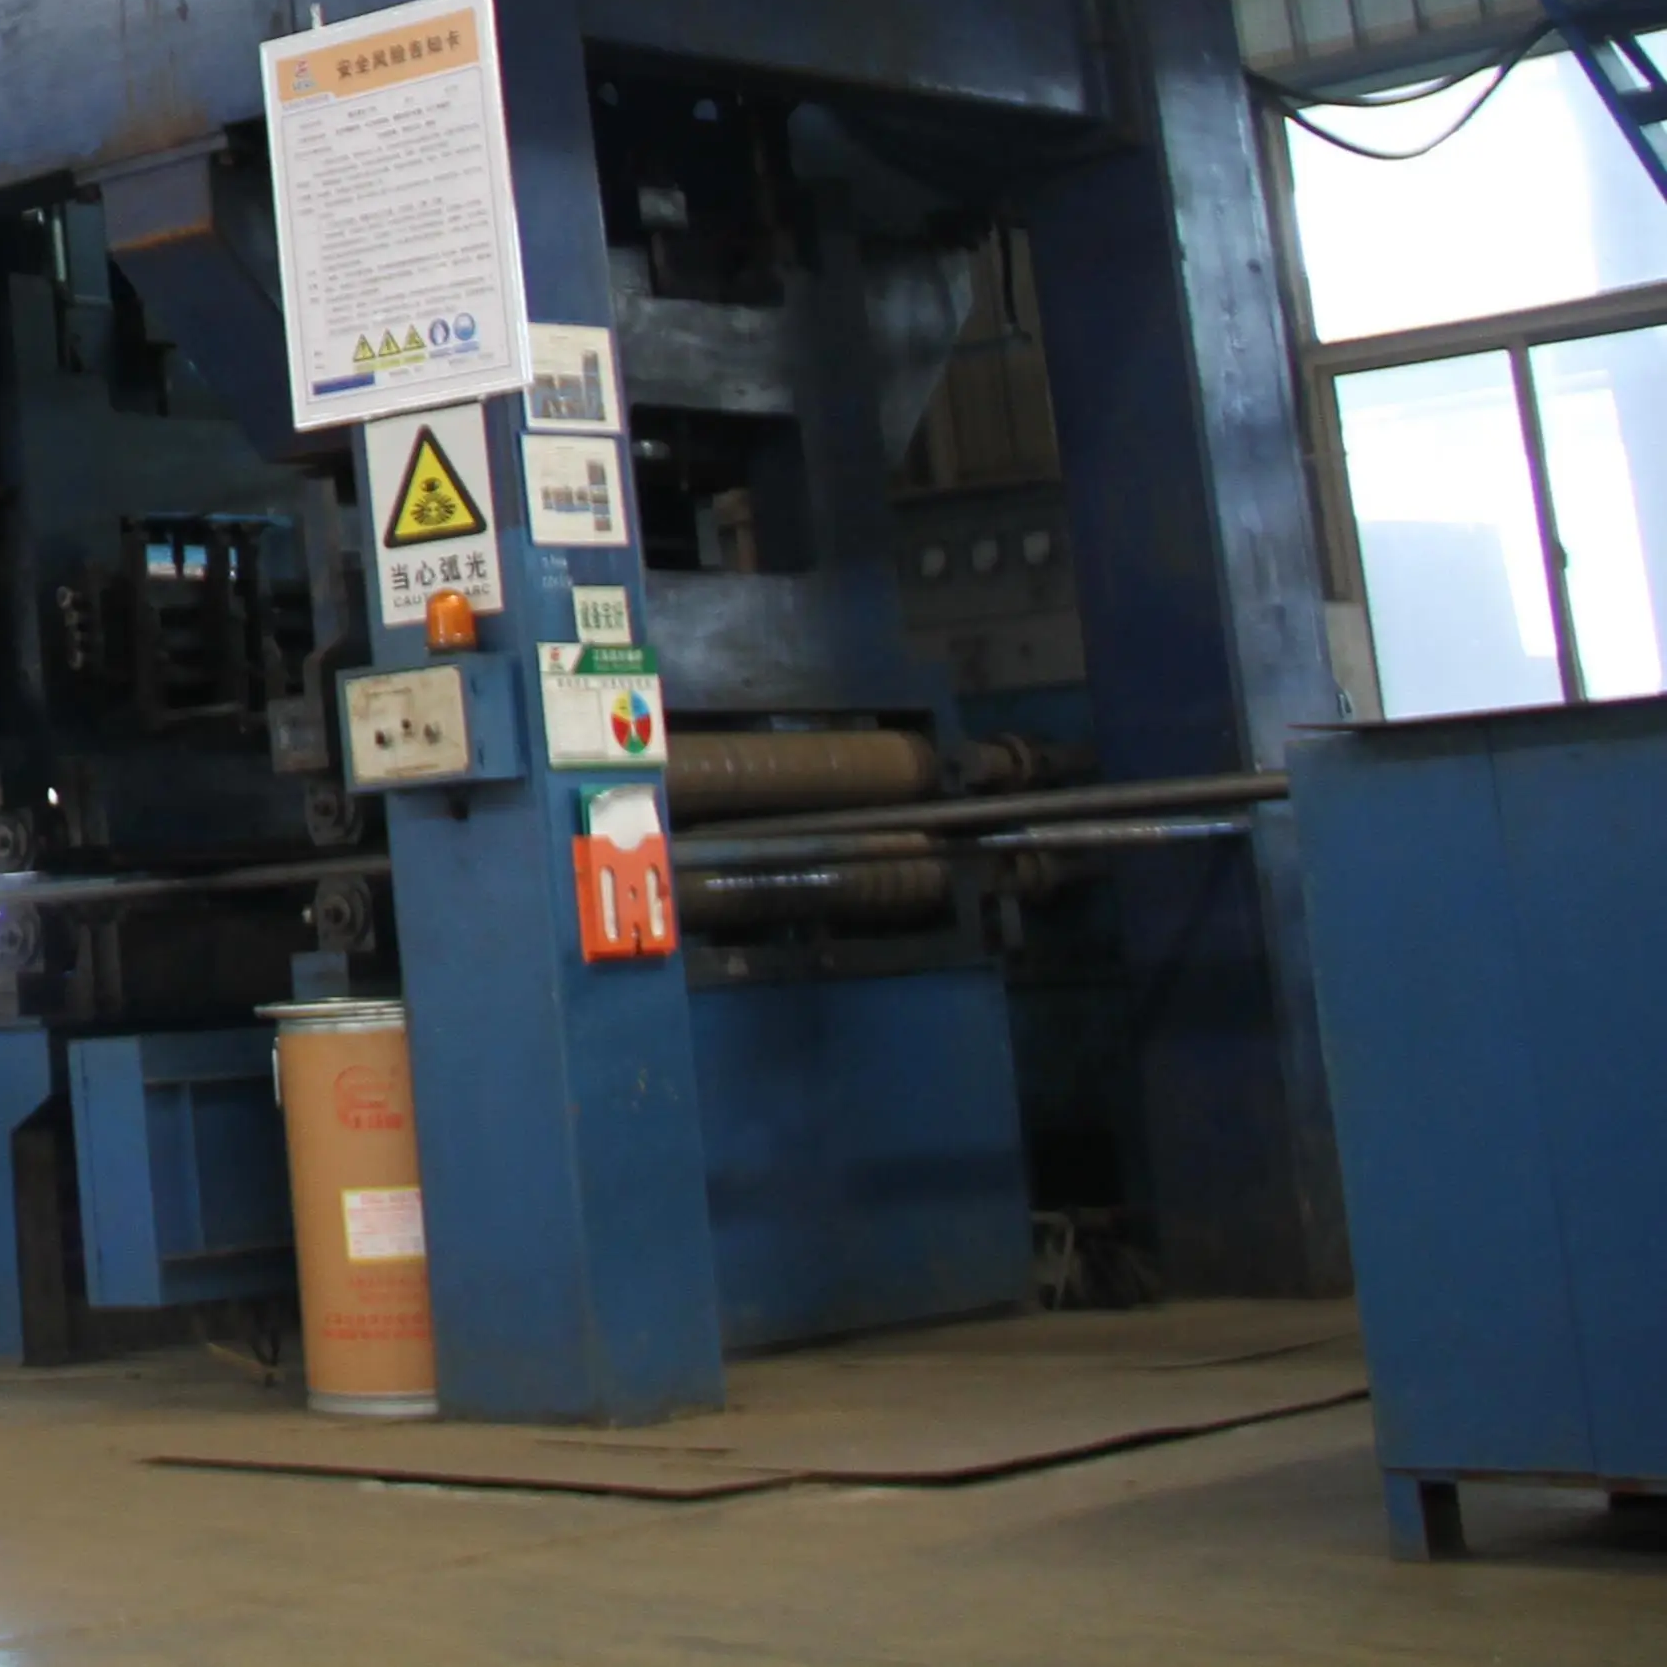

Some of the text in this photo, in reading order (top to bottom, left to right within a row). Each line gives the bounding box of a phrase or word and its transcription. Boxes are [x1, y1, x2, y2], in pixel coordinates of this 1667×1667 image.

[336, 30, 460, 81] 安全风险告知卡
[390, 550, 487, 591] 当心弧光
